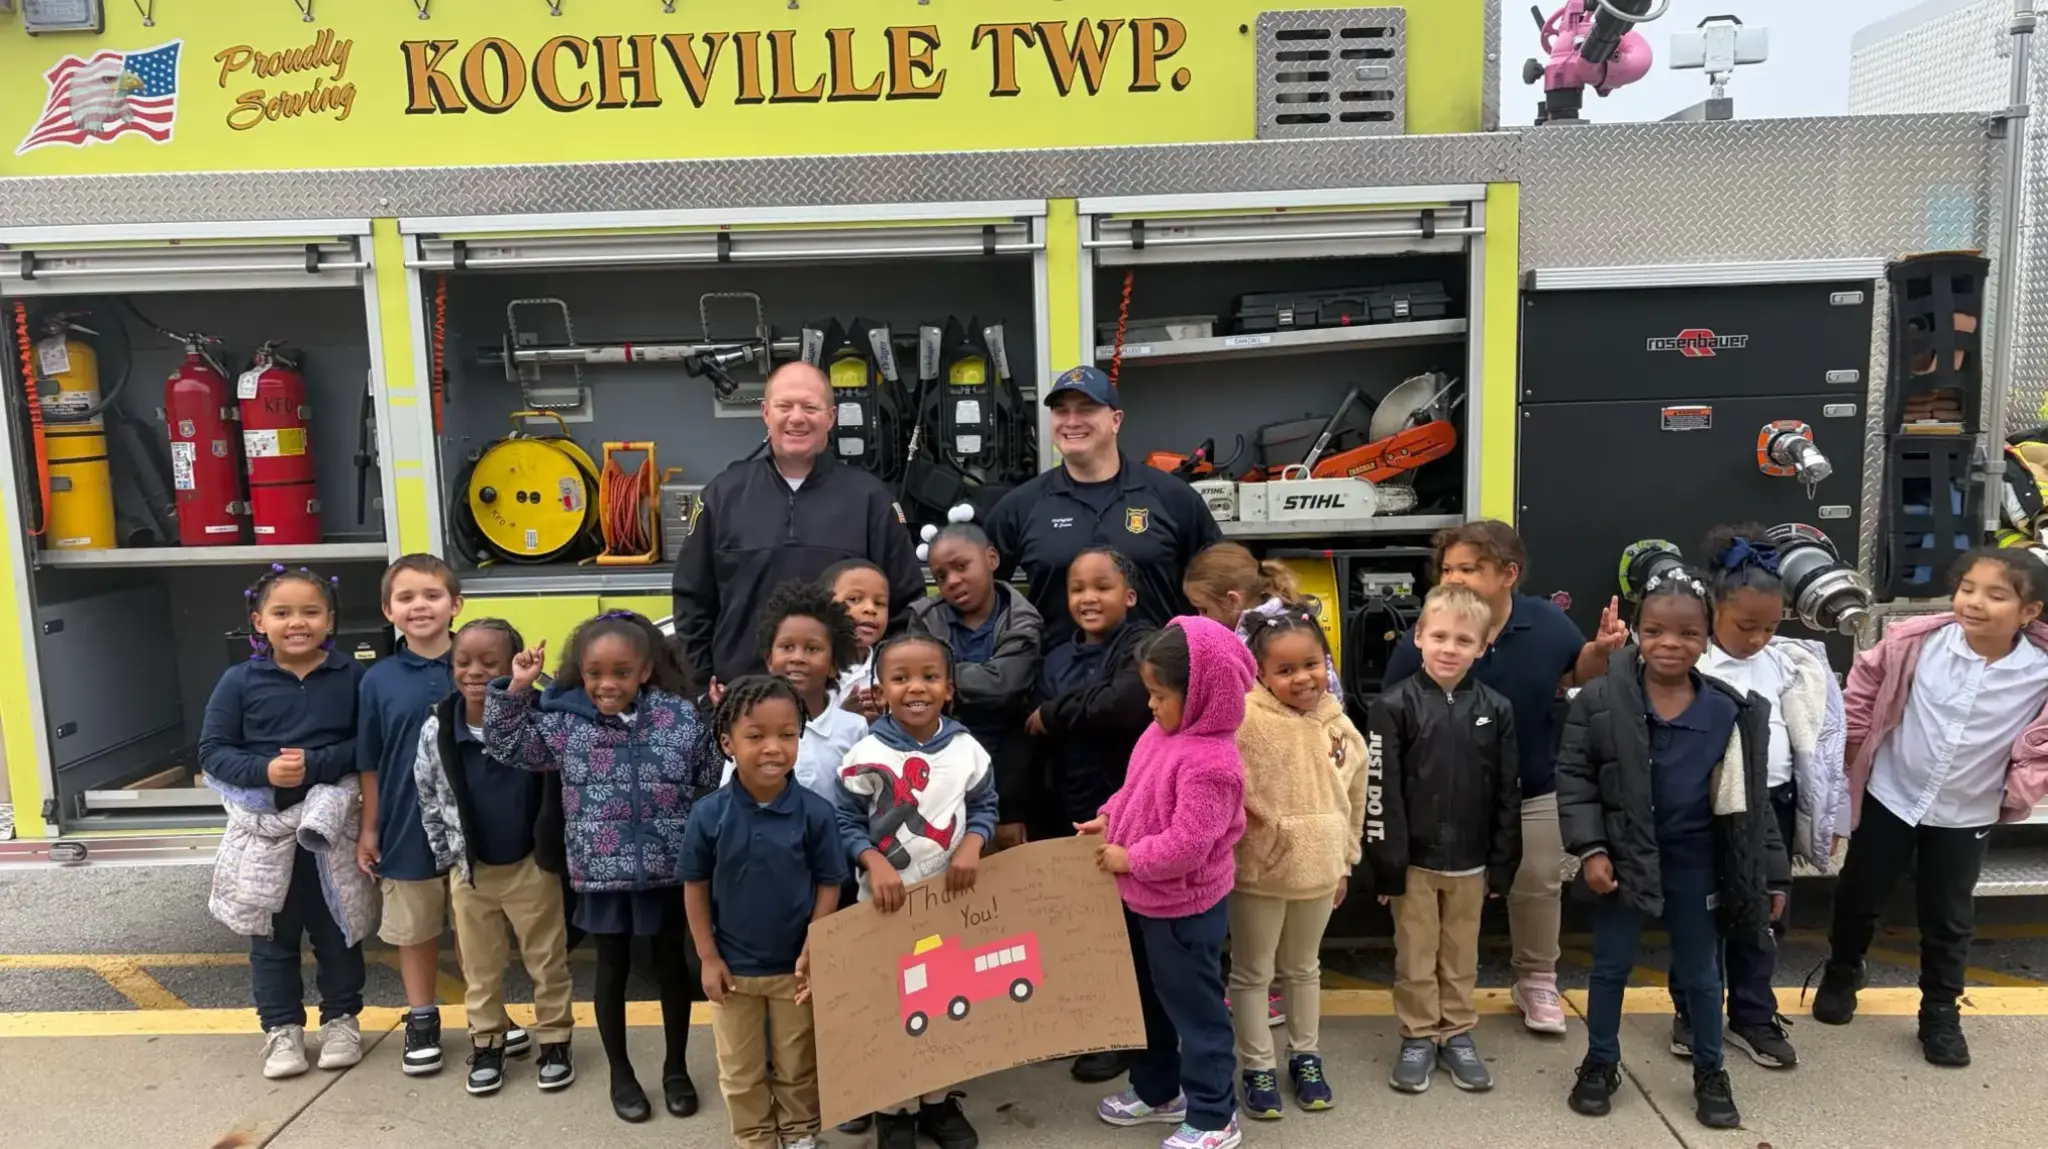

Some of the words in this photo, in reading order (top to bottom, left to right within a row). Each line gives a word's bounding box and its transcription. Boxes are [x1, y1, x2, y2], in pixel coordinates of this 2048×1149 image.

[213, 27, 354, 89] Proudly
[400, 24, 948, 115] KOCHVILLE
[970, 17, 1192, 98] TWP.
[226, 77, 357, 131] Serving
[1646, 332, 1749, 351] rosenbauer
[1201, 487, 1225, 495] STIHL
[1283, 494, 1345, 510] STIHL
[1369, 730, 1383, 780] JUST
[1367, 785, 1384, 816] DO
[1366, 819, 1385, 843] IT.
[960, 895, 999, 929] You!
